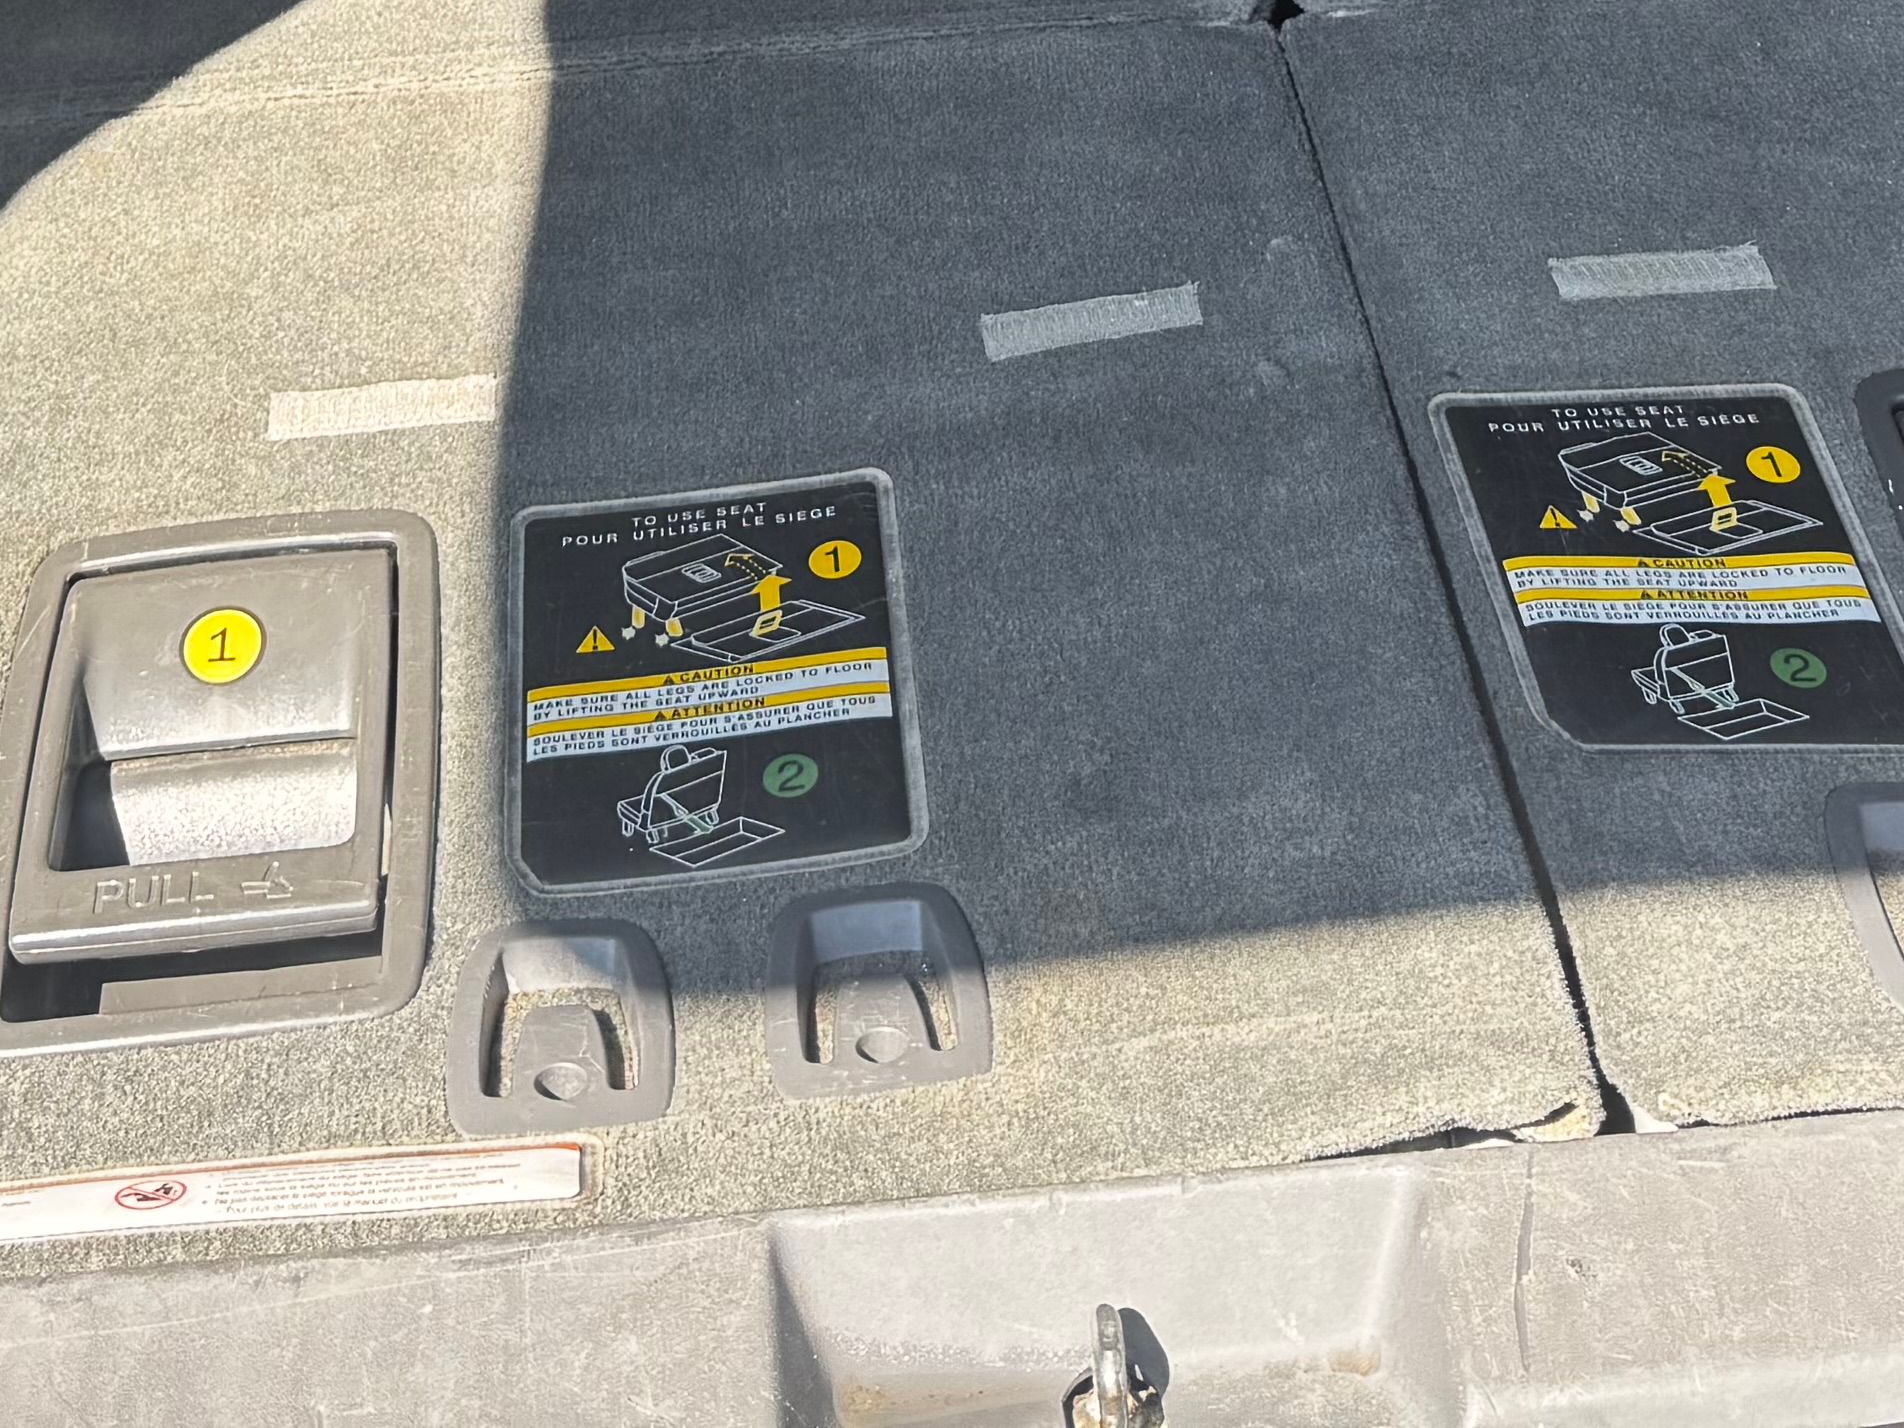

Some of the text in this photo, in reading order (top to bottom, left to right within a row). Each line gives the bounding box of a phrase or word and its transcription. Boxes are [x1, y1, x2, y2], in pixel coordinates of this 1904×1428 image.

[1551, 405, 1684, 418] TO USE SEAT
[1487, 422, 1545, 433] POUR
[1557, 419, 1651, 432] UTILISER
[1664, 417, 1689, 428] LE
[1763, 452, 1785, 478] 1
[632, 502, 767, 527] TO USE SEAT
[561, 532, 618, 546] POUR
[633, 520, 727, 540] UTILISER
[742, 515, 765, 527] LE
[823, 547, 841, 573] 1
[1605, 569, 1630, 577] ALL
[1712, 569, 1769, 579] LOCKED
[1776, 567, 1794, 576] TO
[1800, 565, 1847, 575] FLOOR
[1653, 558, 1726, 569] CAUTION
[1657, 590, 1749, 600] ATTENTION
[207, 626, 236, 663] 1
[625, 691, 651, 701] ALL
[658, 686, 695, 697] LEGS
[701, 681, 729, 692] ARE
[736, 672, 794, 685] LOCKED
[801, 668, 818, 678] TO
[825, 662, 872, 675] FLOOR
[680, 664, 754, 682] CAUTION
[1784, 654, 1817, 683] 2
[622, 700, 648, 710] THE
[698, 687, 759, 700] UPWARD
[671, 697, 765, 718] ATTENTION
[611, 727, 628, 738] LE
[680, 717, 717, 729] POUR
[806, 698, 834, 711] QUE
[533, 744, 557, 755] LES
[755, 719, 772, 729] AU
[778, 708, 850, 725] PLANCHER
[777, 761, 807, 791] 2
[91, 869, 215, 915] PULL
